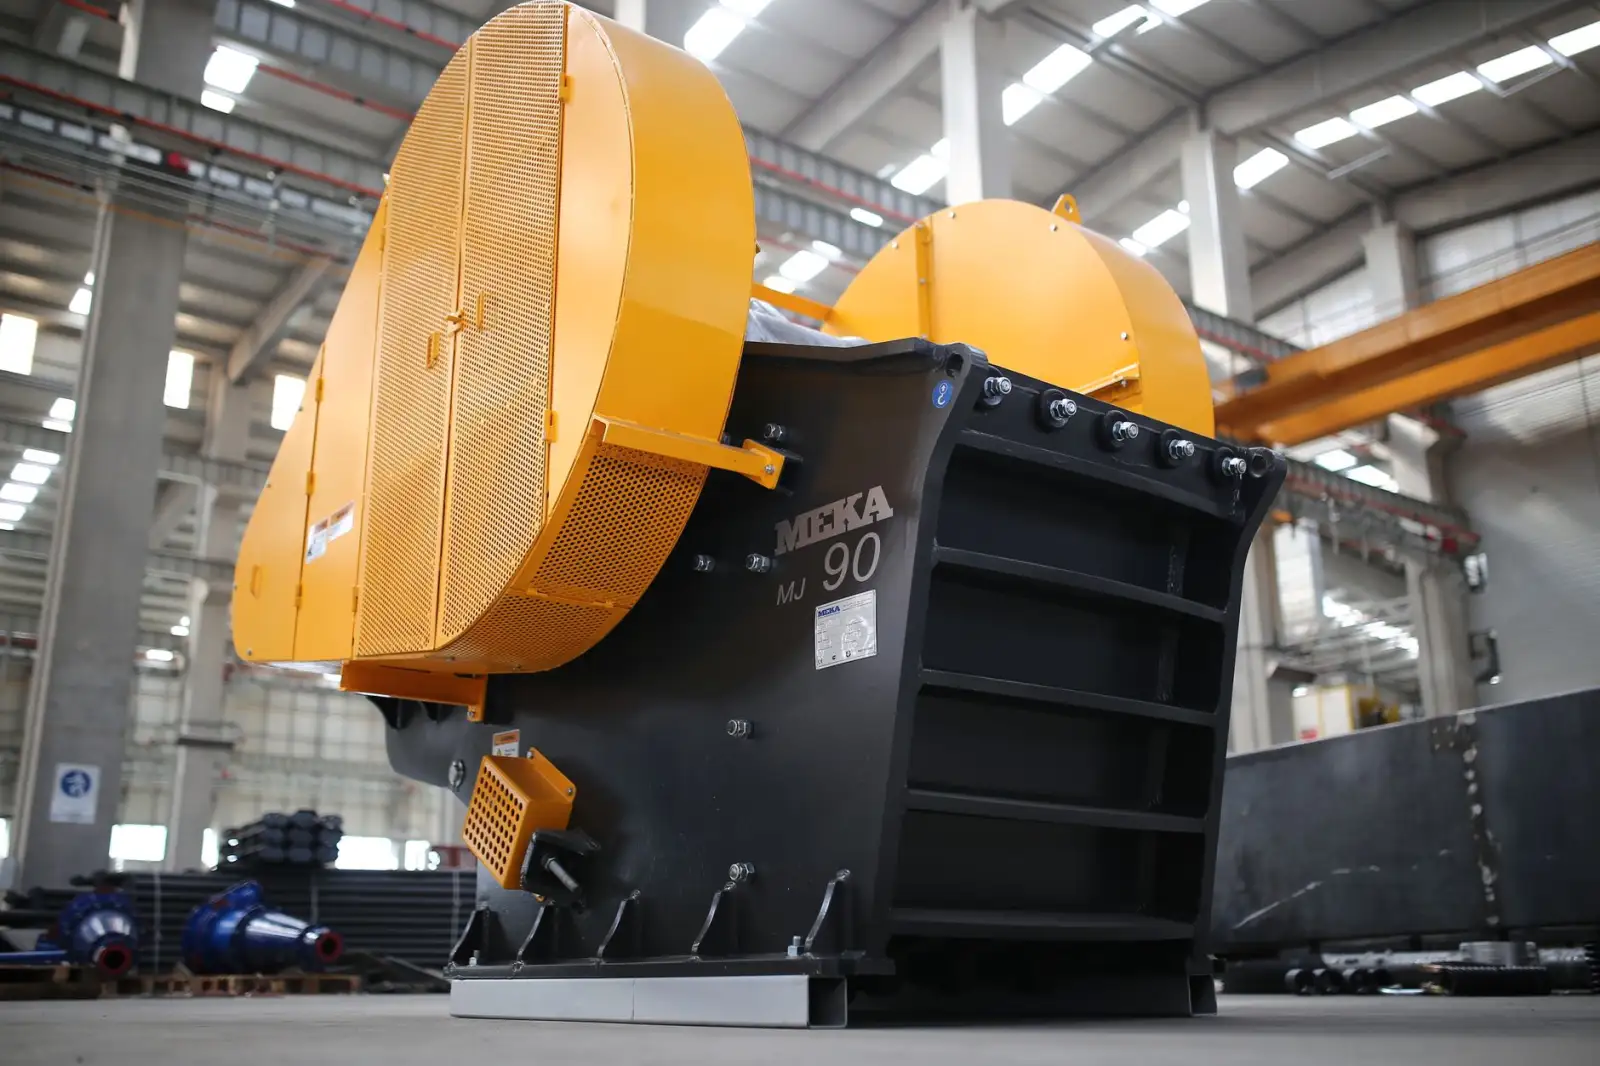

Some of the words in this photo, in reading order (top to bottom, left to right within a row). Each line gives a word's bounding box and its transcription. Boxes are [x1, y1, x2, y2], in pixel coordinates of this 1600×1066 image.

[774, 485, 894, 556] MEKA
[776, 577, 806, 606] MJ
[822, 532, 881, 591] 90
[817, 605, 841, 618] MEKA
